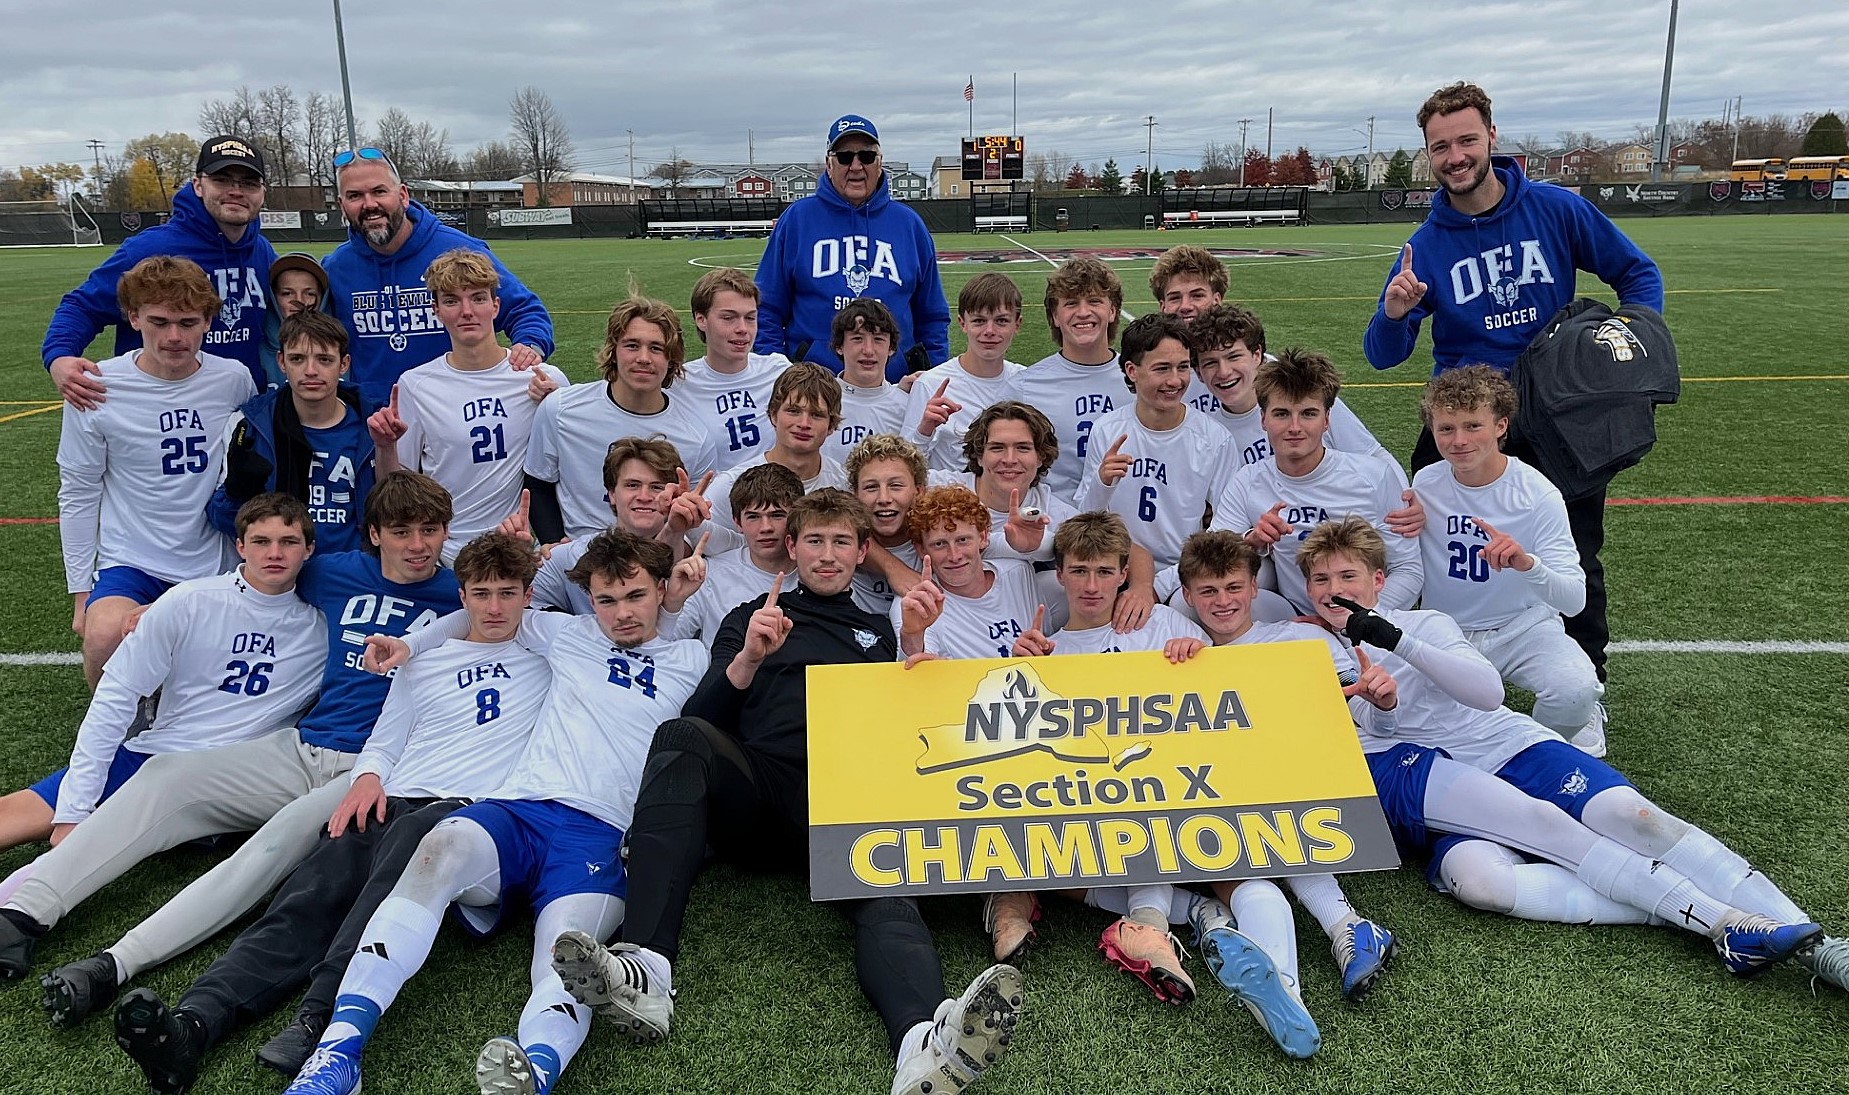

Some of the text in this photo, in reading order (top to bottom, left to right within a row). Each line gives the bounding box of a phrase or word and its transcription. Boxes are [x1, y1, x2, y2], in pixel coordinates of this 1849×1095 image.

[973, 141, 977, 151] 1
[985, 136, 1007, 147] 5:44
[990, 148, 997, 158] 2
[1015, 140, 1021, 151] 0
[502, 210, 553, 224] SUBWAY
[812, 235, 903, 287] OFA
[1450, 239, 1555, 305] OFA
[206, 266, 267, 310] FA
[352, 307, 444, 333] SOCCER
[1484, 306, 1538, 330] SOCCER
[205, 327, 250, 344] SOCCER
[463, 397, 508, 422] OFA
[715, 390, 757, 415] OFA
[1075, 394, 1114, 417] OFA
[159, 408, 205, 433] OFA
[724, 413, 761, 452] 15
[469, 423, 508, 465] 21
[841, 425, 873, 446] OF
[160, 435, 209, 476] 25
[1132, 457, 1168, 486] OFA
[1138, 485, 1157, 523] 6
[1287, 506, 1330, 525] OFA
[1447, 515, 1490, 542] OFA
[1447, 541, 1490, 583] 20
[339, 593, 438, 634] OFA
[231, 632, 276, 659] OFA
[217, 659, 274, 697] 26
[457, 662, 512, 690] OFA
[606, 657, 658, 700] 24
[475, 687, 501, 726] 8
[963, 690, 1254, 744] NYSPHSAA
[956, 764, 1222, 812] Section X
[848, 806, 1356, 888] CHAMPIONS
